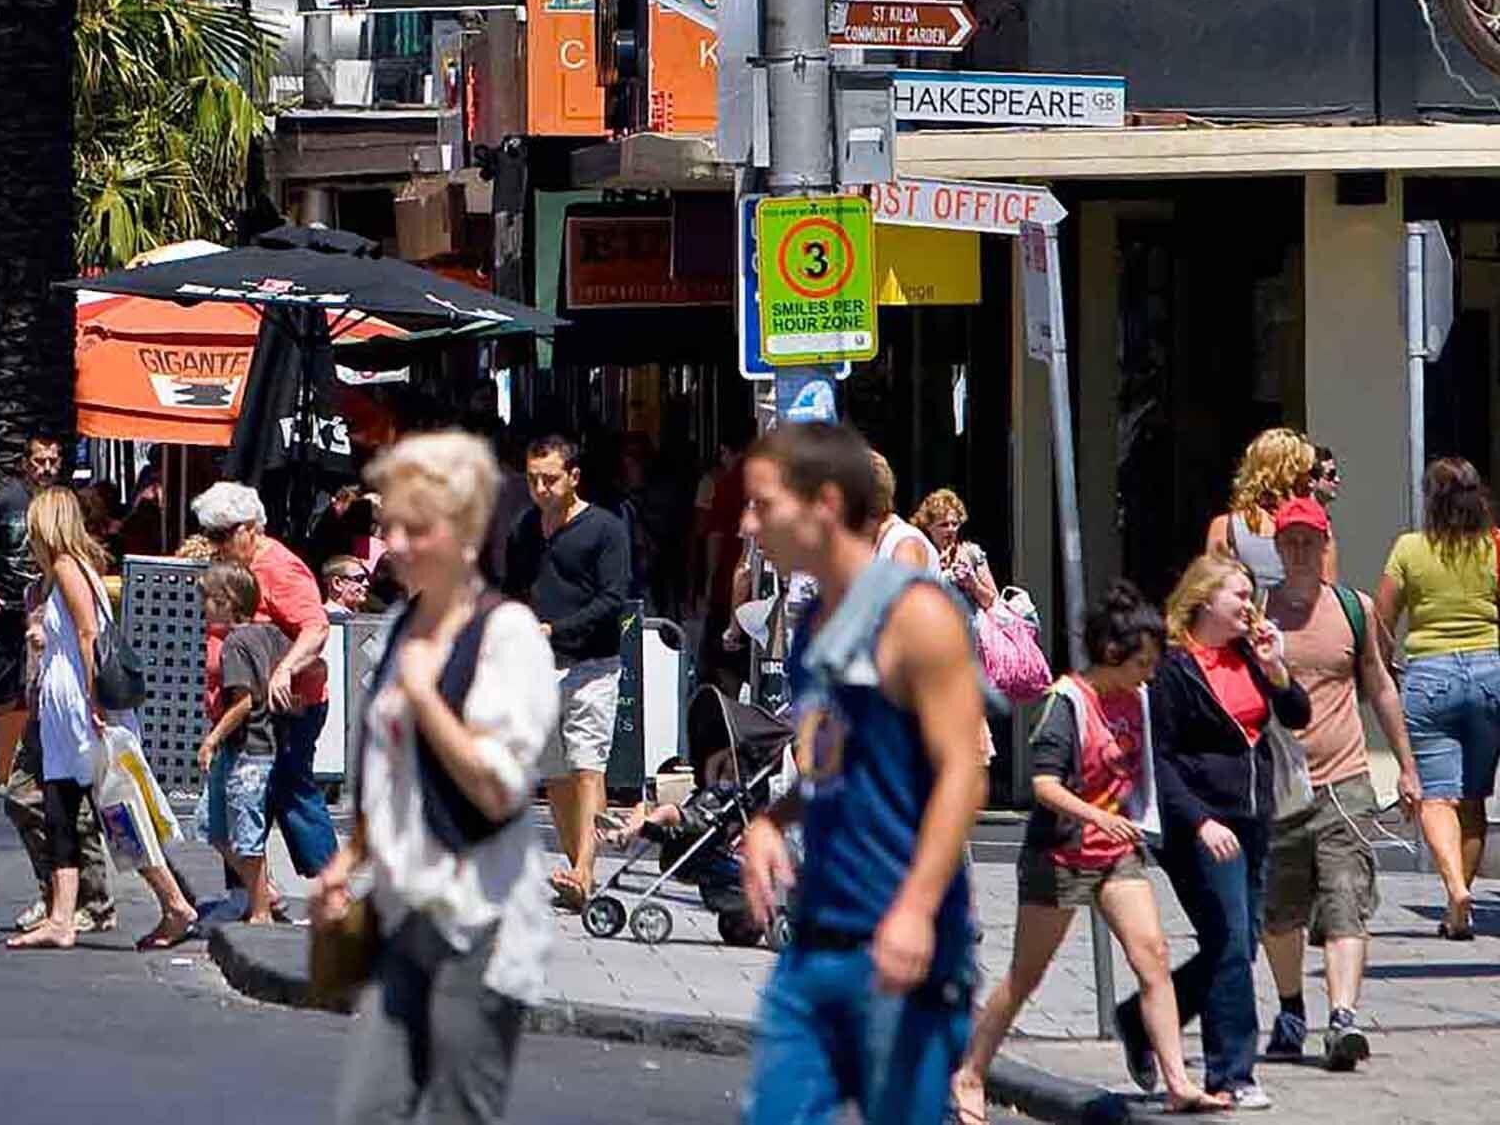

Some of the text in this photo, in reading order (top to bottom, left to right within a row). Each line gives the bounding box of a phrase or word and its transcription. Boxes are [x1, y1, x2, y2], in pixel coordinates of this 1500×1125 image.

[871, 6, 918, 23] ST KILDA
[843, 25, 946, 44] COMMUNITY GARDEN
[893, 86, 1085, 118] HAKESPEARE
[845, 182, 1040, 224] OST OFFICE
[804, 241, 829, 279] 3
[771, 298, 866, 317] SMILES PER
[772, 314, 866, 332] HOUR ZONE
[138, 347, 250, 375] GIGANTE
